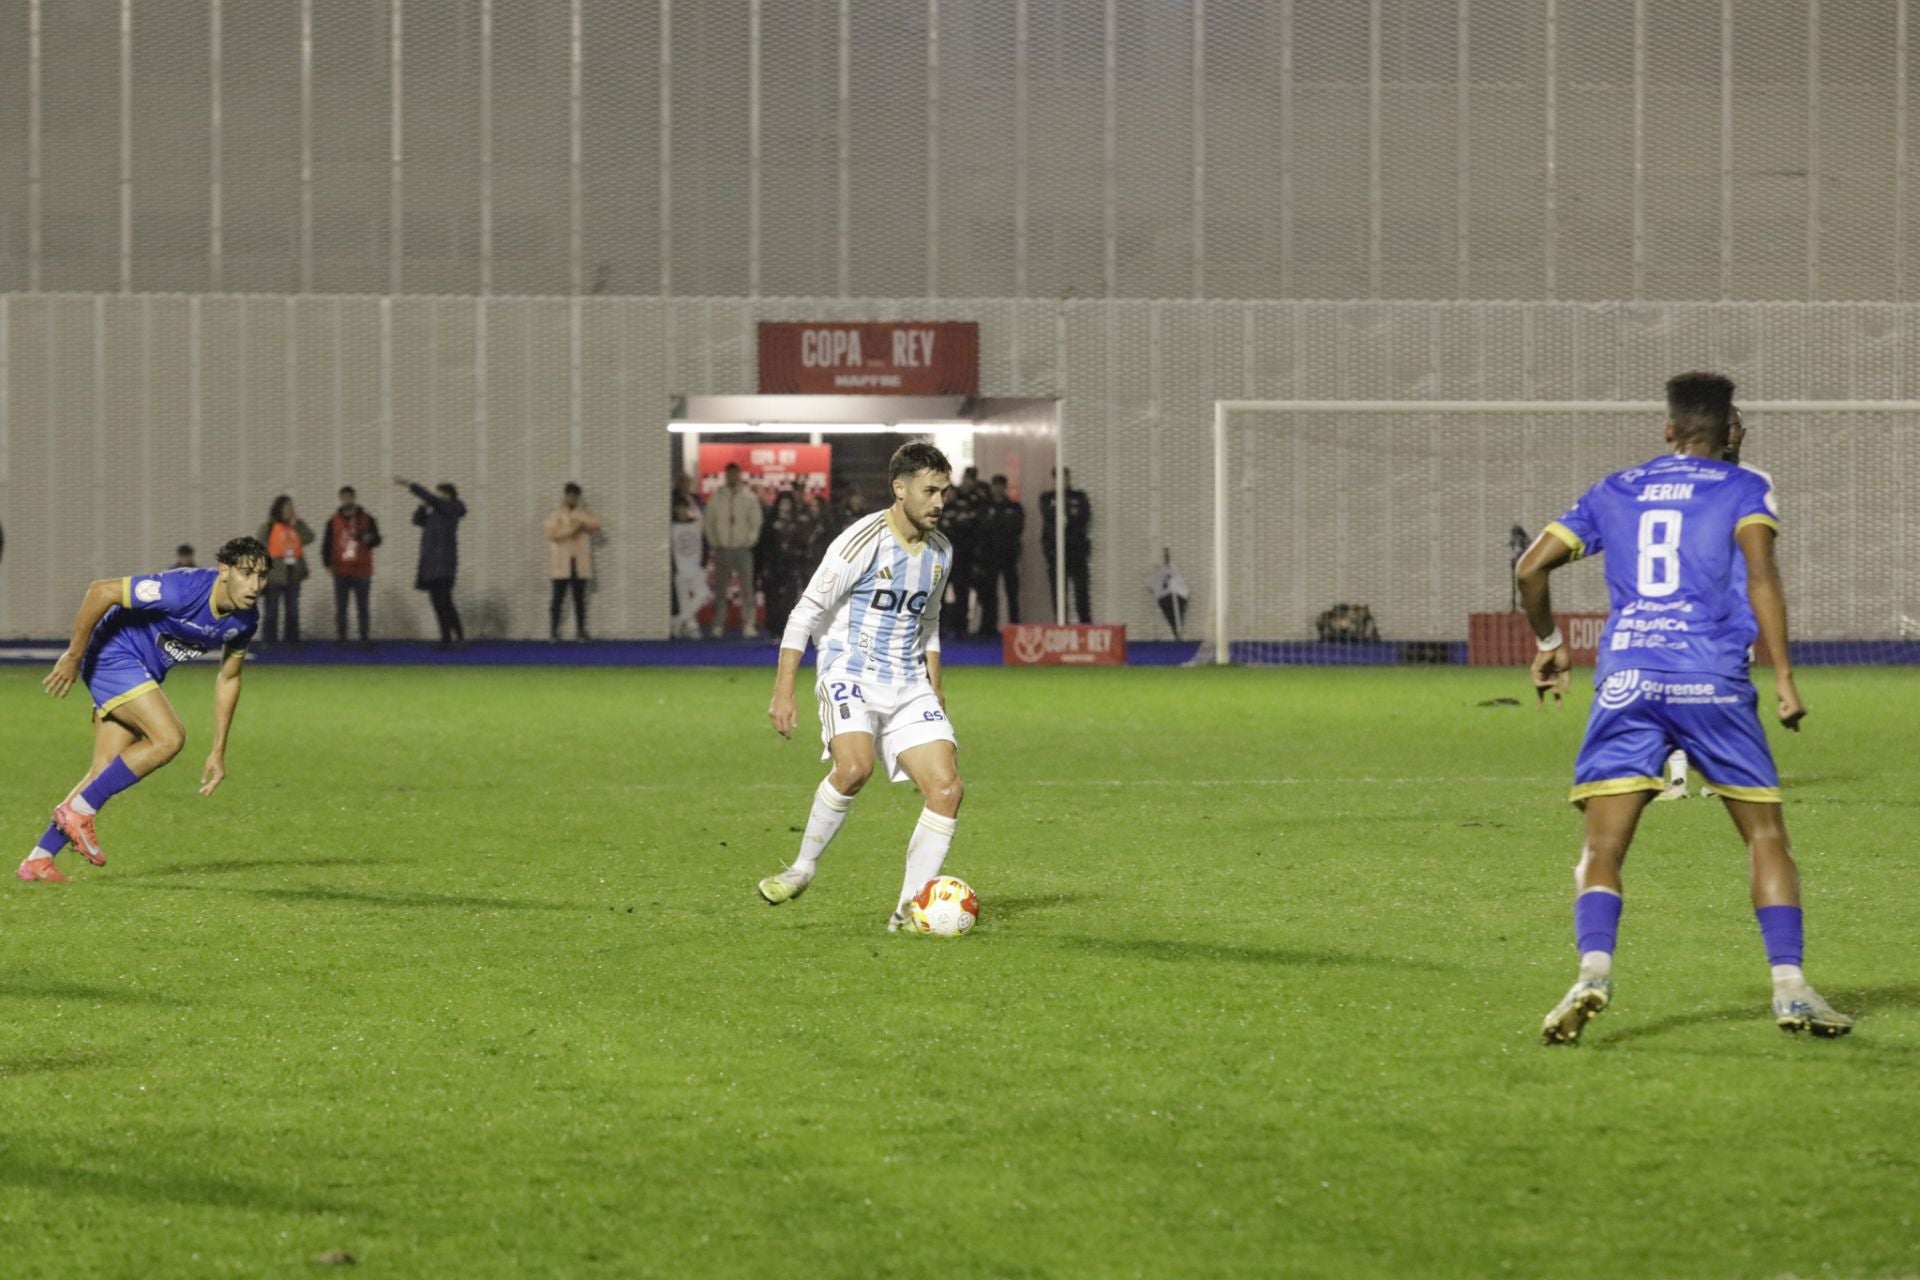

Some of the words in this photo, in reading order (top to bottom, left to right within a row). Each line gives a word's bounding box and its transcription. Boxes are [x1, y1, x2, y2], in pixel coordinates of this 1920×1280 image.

[801, 329, 862, 367] COPA
[892, 329, 935, 367] REY
[1636, 483, 1694, 502] JERIN
[1636, 508, 1683, 598] 8
